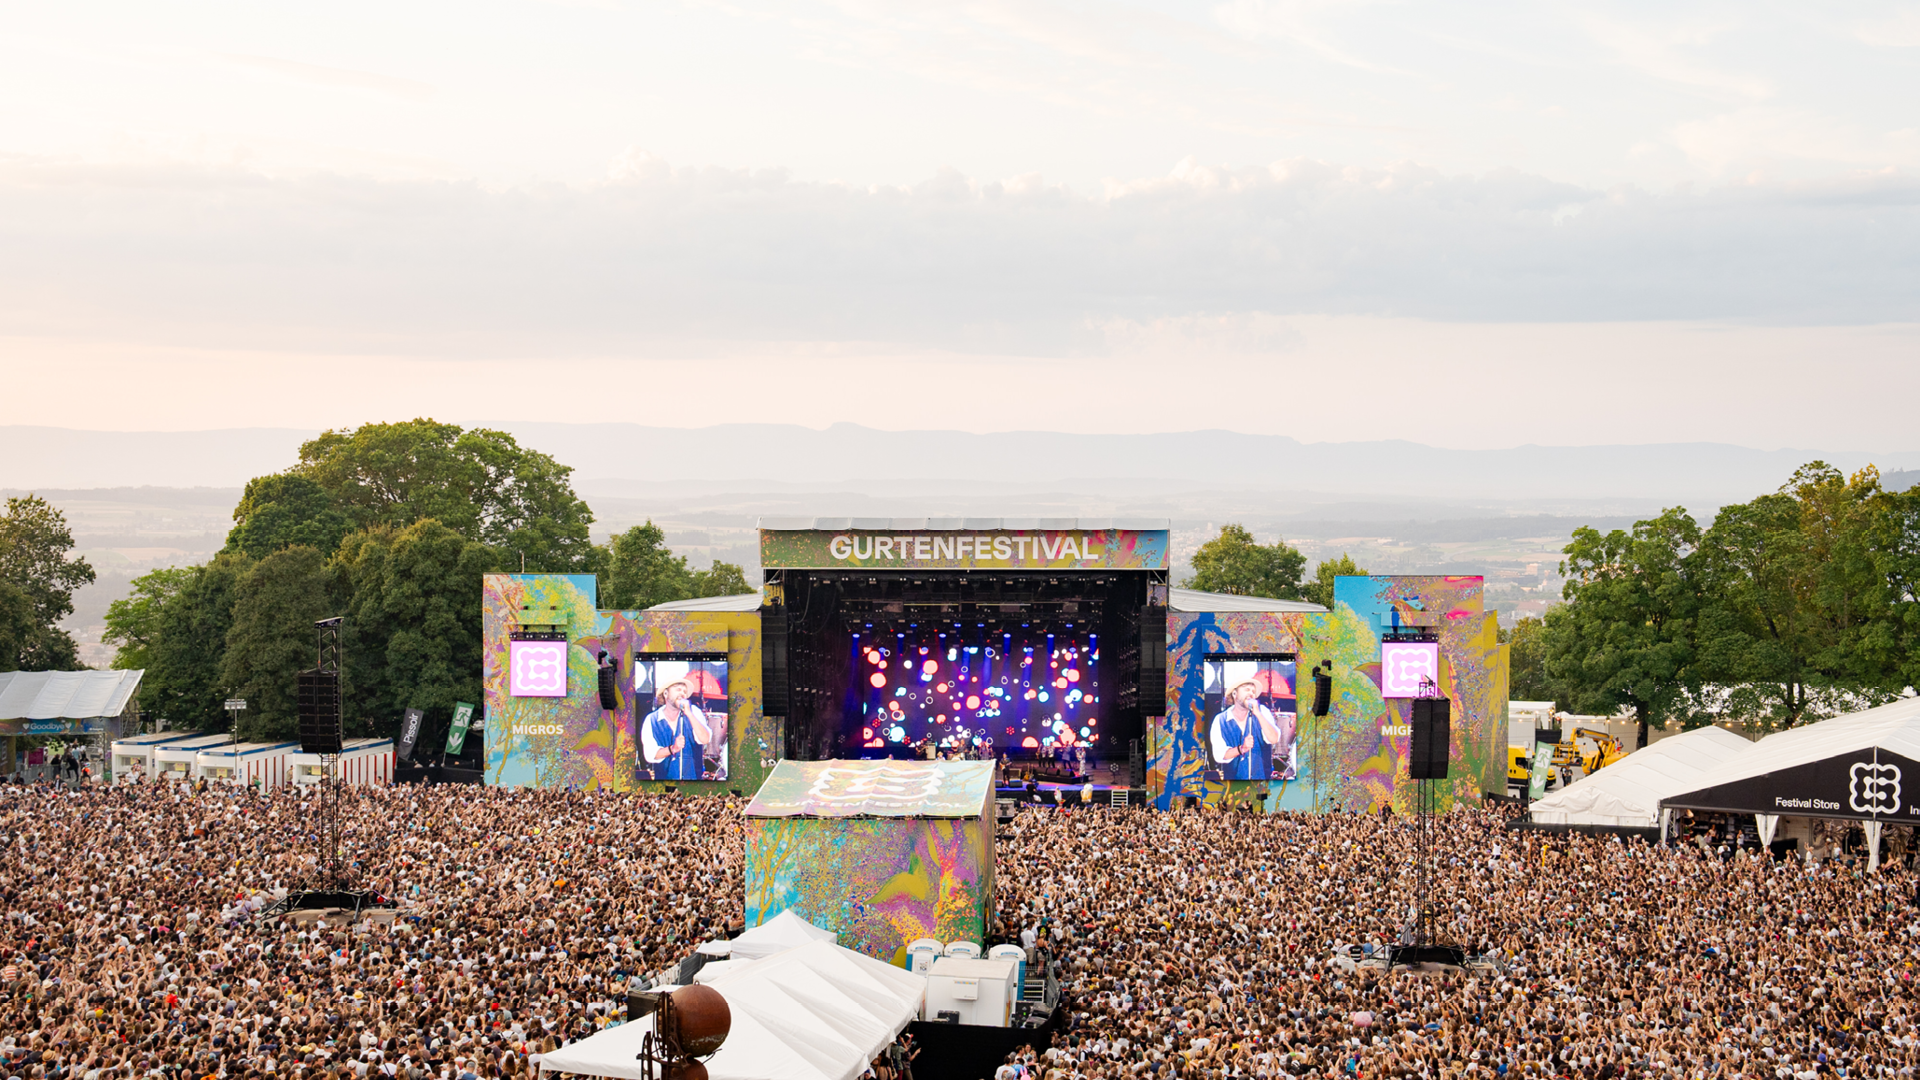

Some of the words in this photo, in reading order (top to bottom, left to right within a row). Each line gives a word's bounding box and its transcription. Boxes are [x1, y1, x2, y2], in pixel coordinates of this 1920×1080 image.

[830, 536, 1099, 560] GURTENFESTIVAL
[30, 722, 65, 731] Goodbye
[403, 712, 419, 745] Pissoir
[512, 724, 564, 735] MIGROS
[1775, 796, 1812, 808] Festival
[1813, 798, 1840, 810] Store
